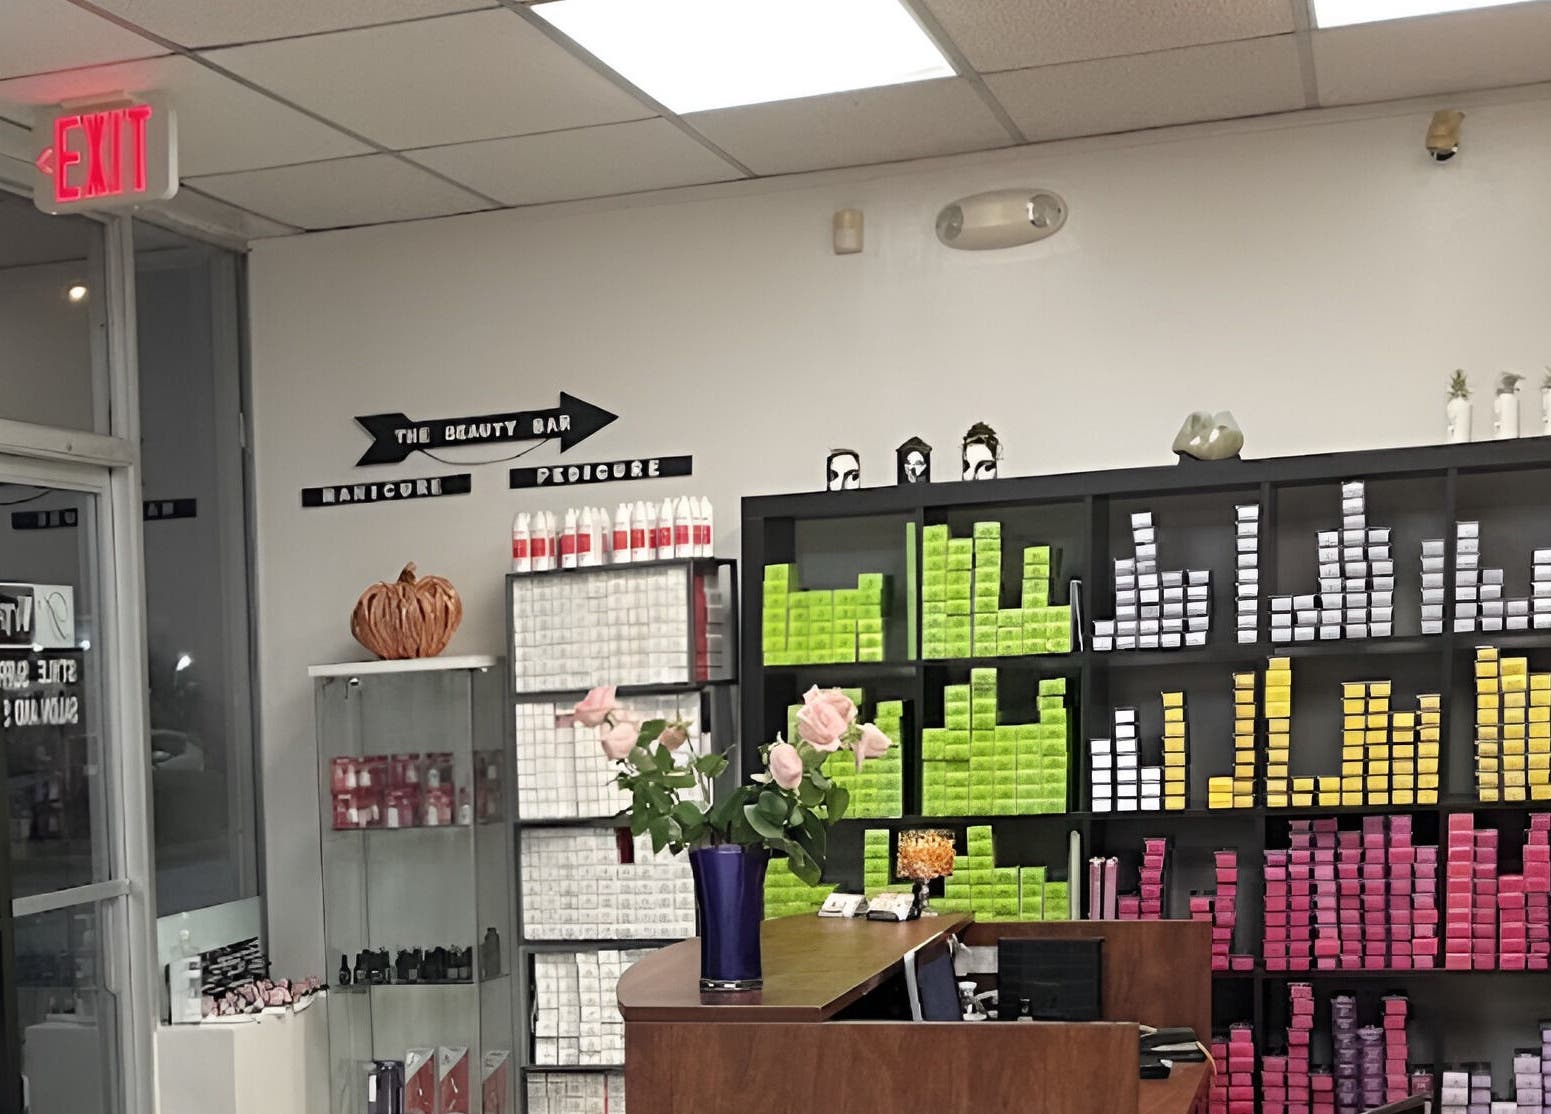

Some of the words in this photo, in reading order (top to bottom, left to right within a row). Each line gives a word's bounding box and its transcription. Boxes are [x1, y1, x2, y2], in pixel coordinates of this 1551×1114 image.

[54, 104, 152, 204] EXIT
[395, 427, 430, 445] THE
[445, 420, 517, 441] BEAUTY
[532, 414, 570, 435] BAR
[536, 459, 660, 485] PEDICURE
[322, 478, 442, 504] MANICURE
